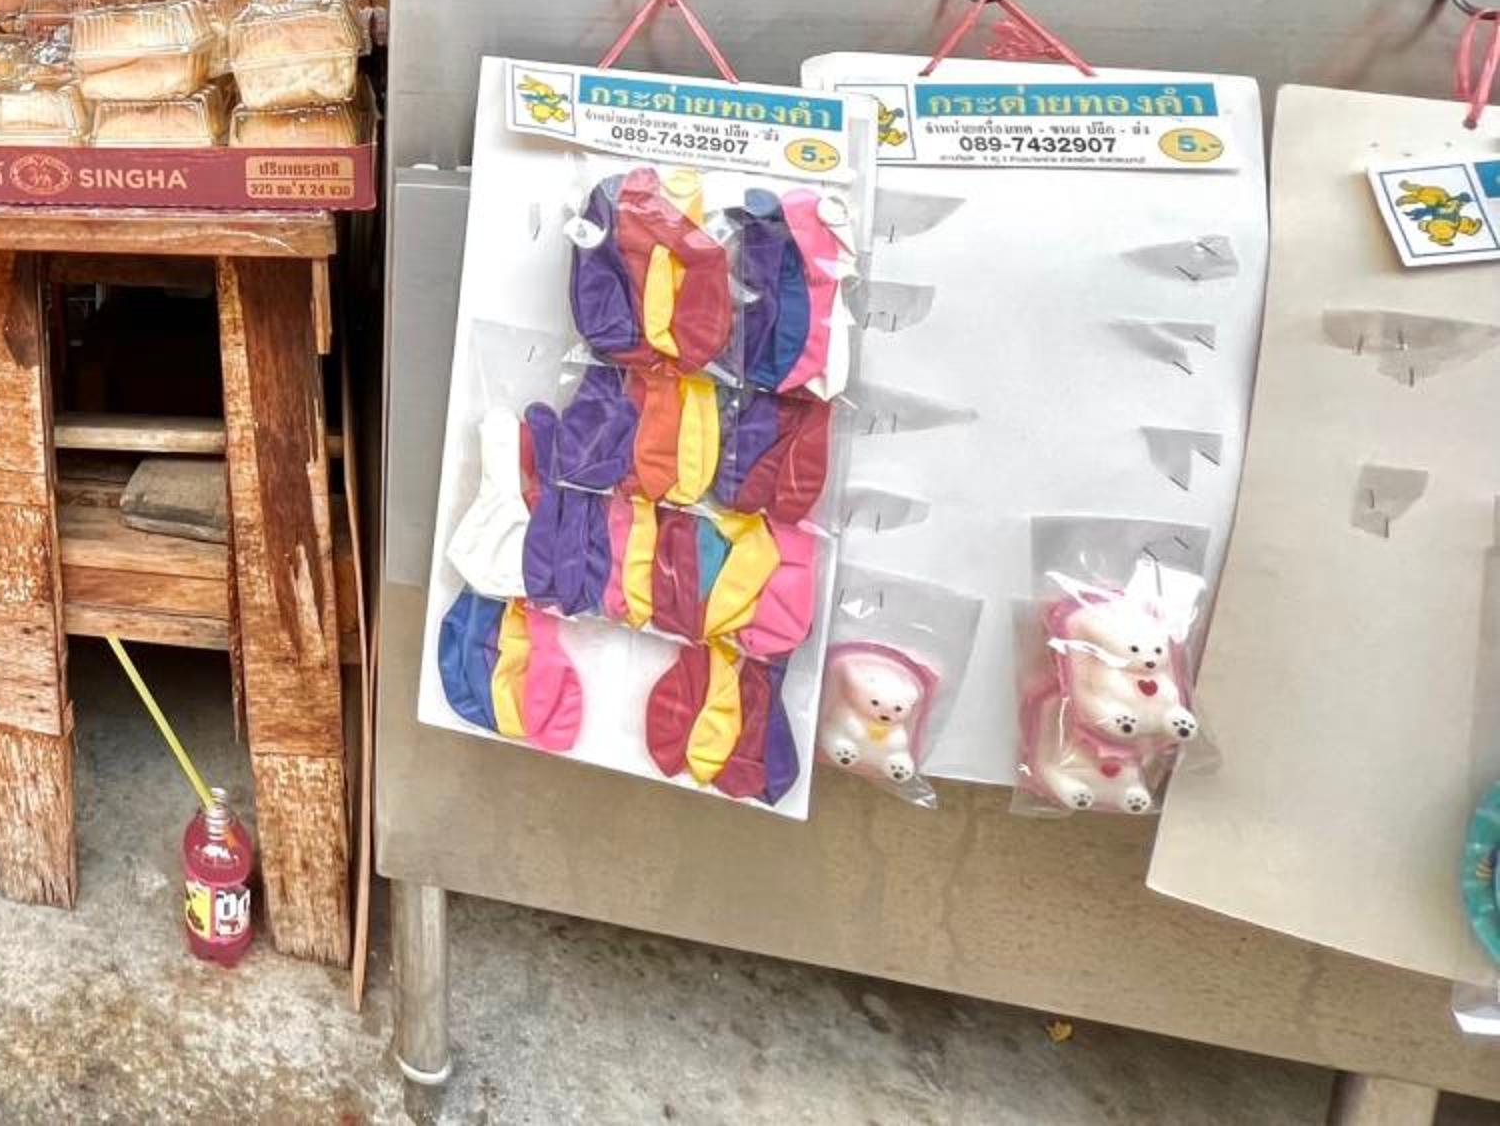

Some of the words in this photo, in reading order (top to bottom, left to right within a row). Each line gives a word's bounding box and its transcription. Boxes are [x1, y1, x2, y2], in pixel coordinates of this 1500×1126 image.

[589, 83, 832, 129] กระต่ายทองคำ
[930, 86, 1205, 116] กระต่ายทองคำ
[611, 126, 749, 155] 089-7432907
[959, 136, 1117, 153] 089-7432907
[1175, 135, 1221, 154] 5.-
[800, 145, 838, 165] 5.-
[79, 169, 188, 190] SINGHA
[310, 183, 326, 196] 24
